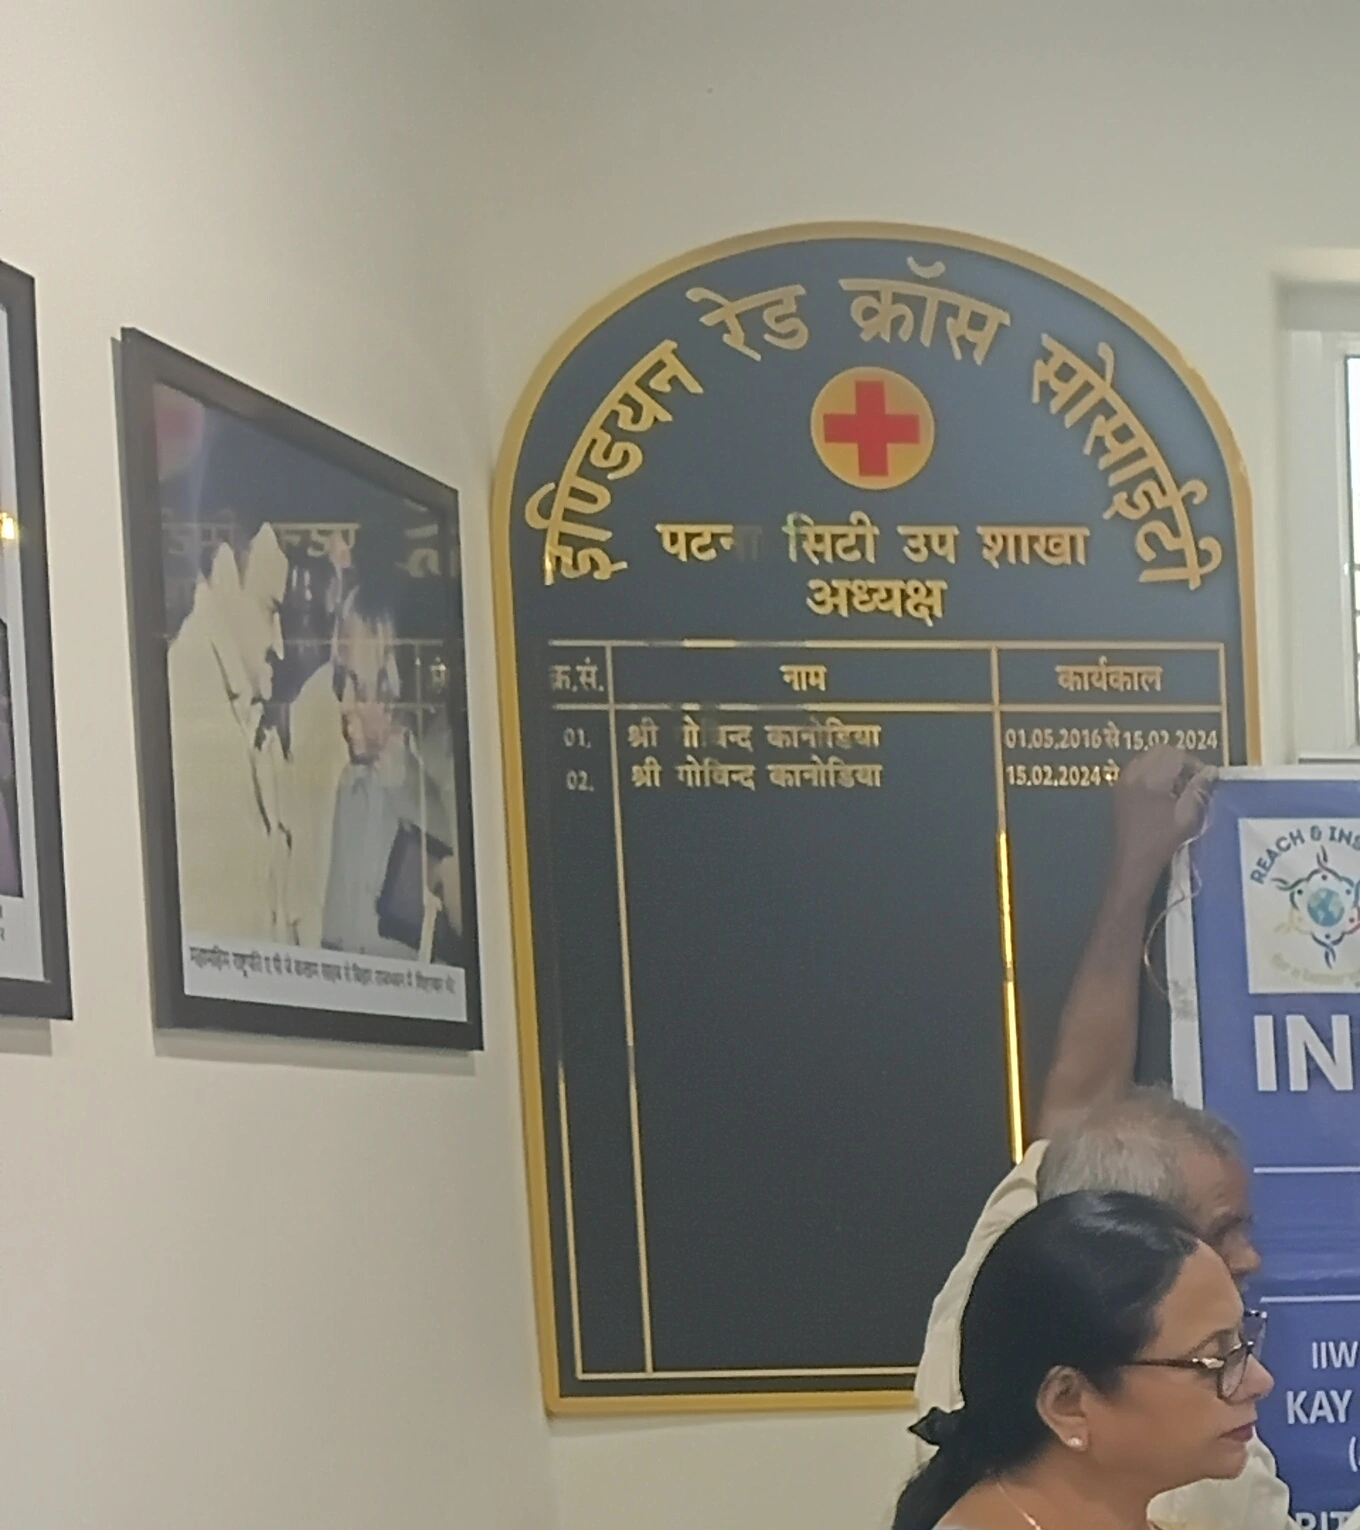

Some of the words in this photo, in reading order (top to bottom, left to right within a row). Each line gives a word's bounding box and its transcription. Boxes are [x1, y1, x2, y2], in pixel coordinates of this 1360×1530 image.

[525, 339, 703, 586] इण्डियन
[685, 284, 808, 361] रेड
[838, 255, 1010, 366] क्रॉस
[1031, 333, 1222, 590] सोसाईटी
[782, 511, 879, 565] सिटी
[897, 524, 958, 564] उप
[976, 524, 1089, 568] शाखा
[806, 578, 948, 626] अध्यक्ष
[780, 664, 828, 691] नाम
[1055, 655, 1163, 692] कार्यकाल
[563, 727, 592, 749] 01.
[627, 716, 660, 749] श्री
[1004, 728, 1102, 750] 01.05.2016
[1103, 720, 1121, 749] से
[1124, 730, 1219, 750] 15.022024
[566, 770, 594, 792] 02.
[631, 756, 662, 788] श्री
[677, 754, 756, 791] गोविन्द
[767, 754, 883, 788] कानोडिया
[1006, 765, 1102, 787] 15.02.2024
[1250, 828, 1306, 885] REACH
[1311, 1340, 1359, 1369] IIW
[1286, 1388, 1353, 1425] KAY
